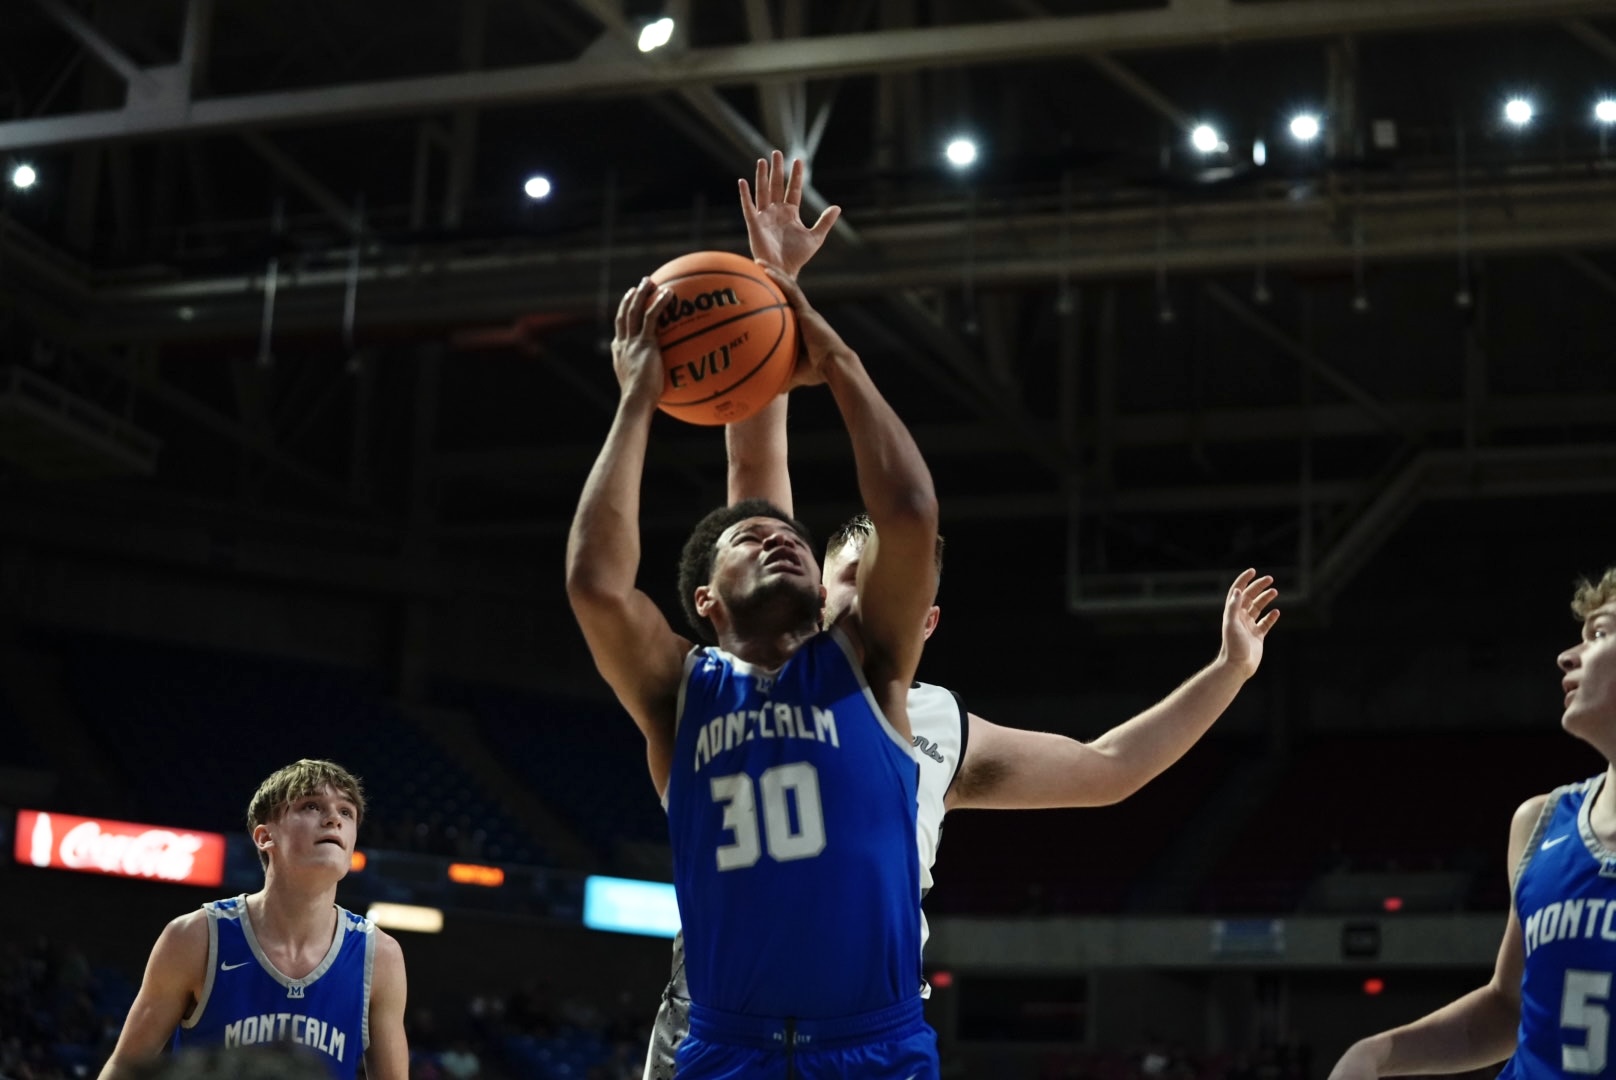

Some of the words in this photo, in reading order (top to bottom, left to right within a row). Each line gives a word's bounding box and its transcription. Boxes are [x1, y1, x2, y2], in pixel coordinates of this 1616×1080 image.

[658, 287, 738, 328] ilson
[669, 345, 730, 388] EVO
[710, 761, 827, 872] 30
[224, 1012, 346, 1063] MONTCALM
[1560, 968, 1612, 1075] 5
